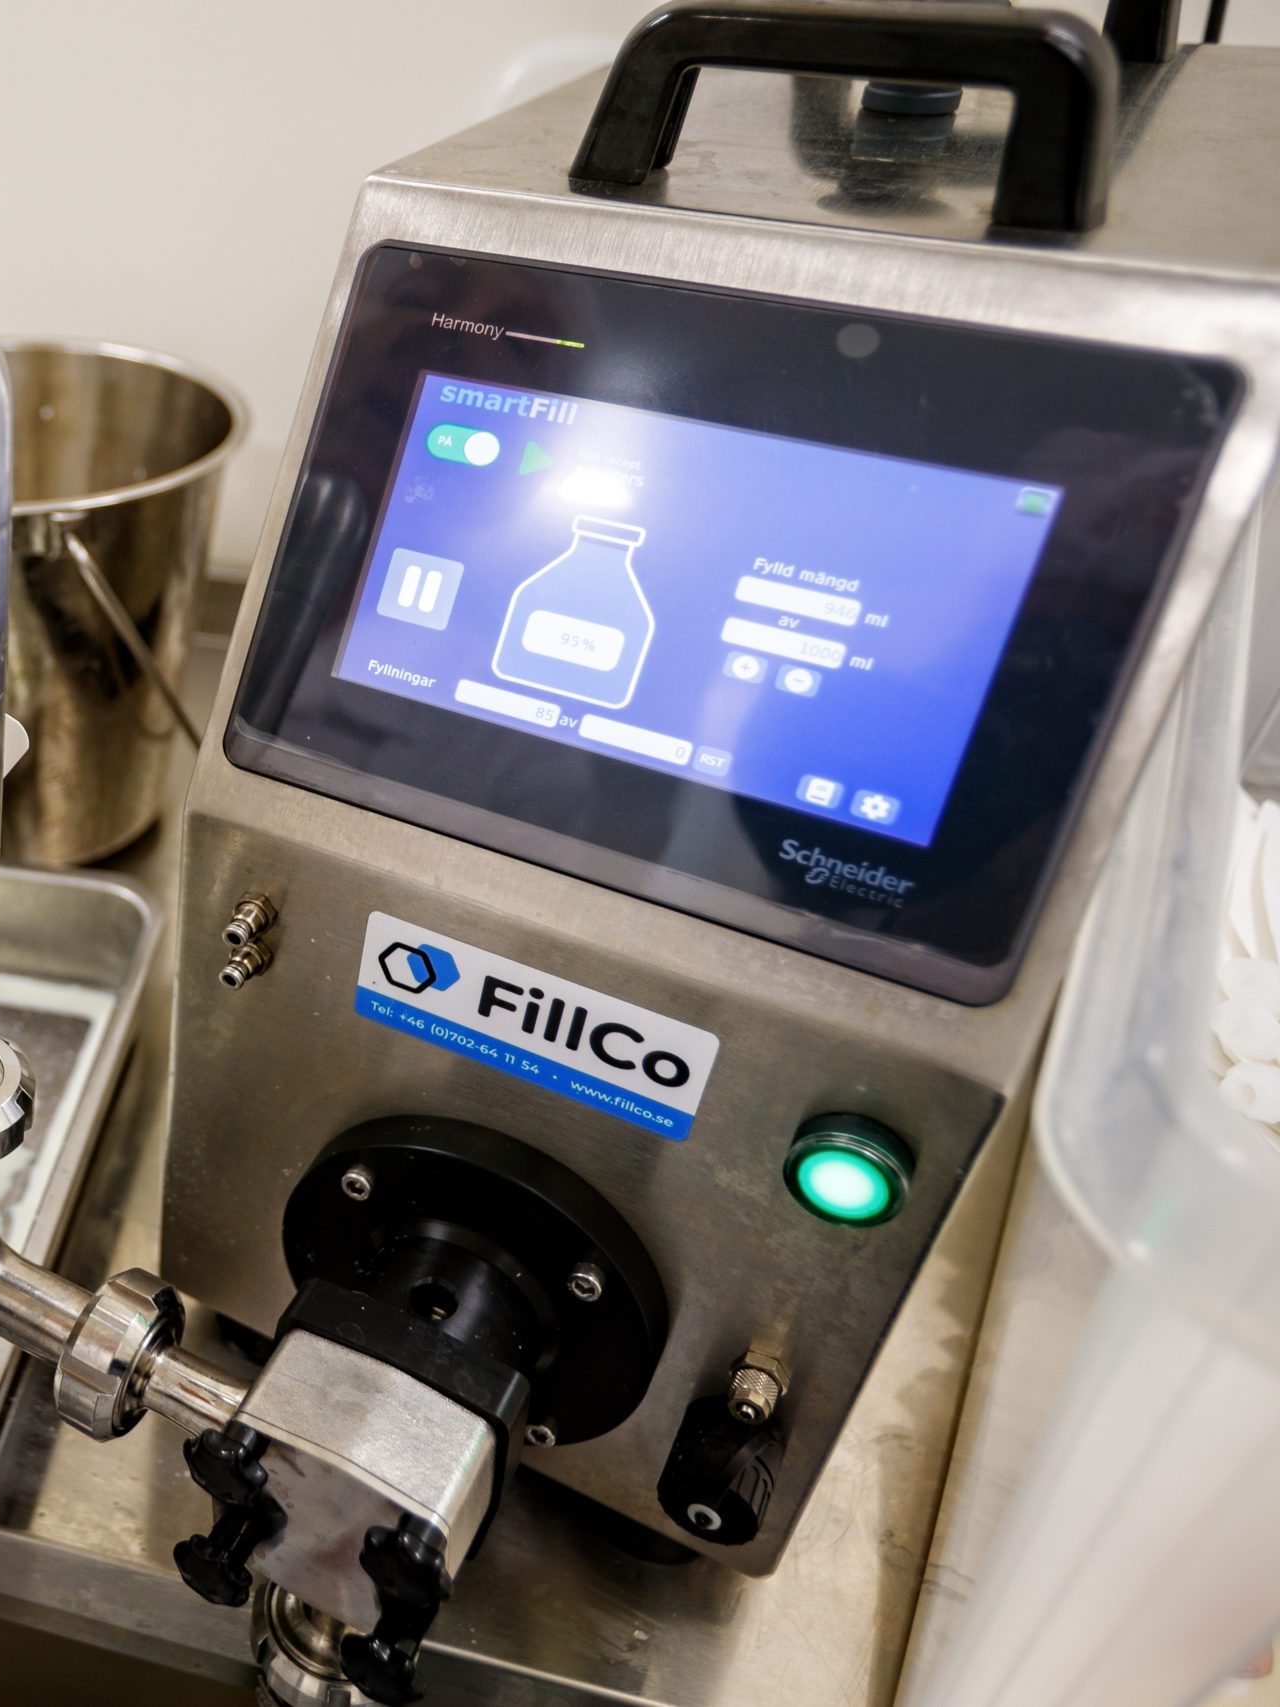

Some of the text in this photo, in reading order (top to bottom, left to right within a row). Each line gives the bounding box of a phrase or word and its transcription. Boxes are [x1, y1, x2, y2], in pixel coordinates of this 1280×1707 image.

[432, 312, 504, 341] Harmony
[440, 385, 579, 425] smartFill
[753, 556, 860, 592] Fylld mängd
[778, 615, 800, 628] av
[824, 602, 889, 627] 946 ml
[800, 642, 874, 671] 1000 ml
[368, 659, 686, 759] Fyllningar 85 av 0
[700, 753, 726, 769] RST
[778, 838, 915, 894] Schneider
[829, 875, 904, 908] Electric
[478, 975, 690, 1088] FillCo
[370, 1000, 674, 1128] Tel: +46 (0)702-64 11 54 www.fillco.se
